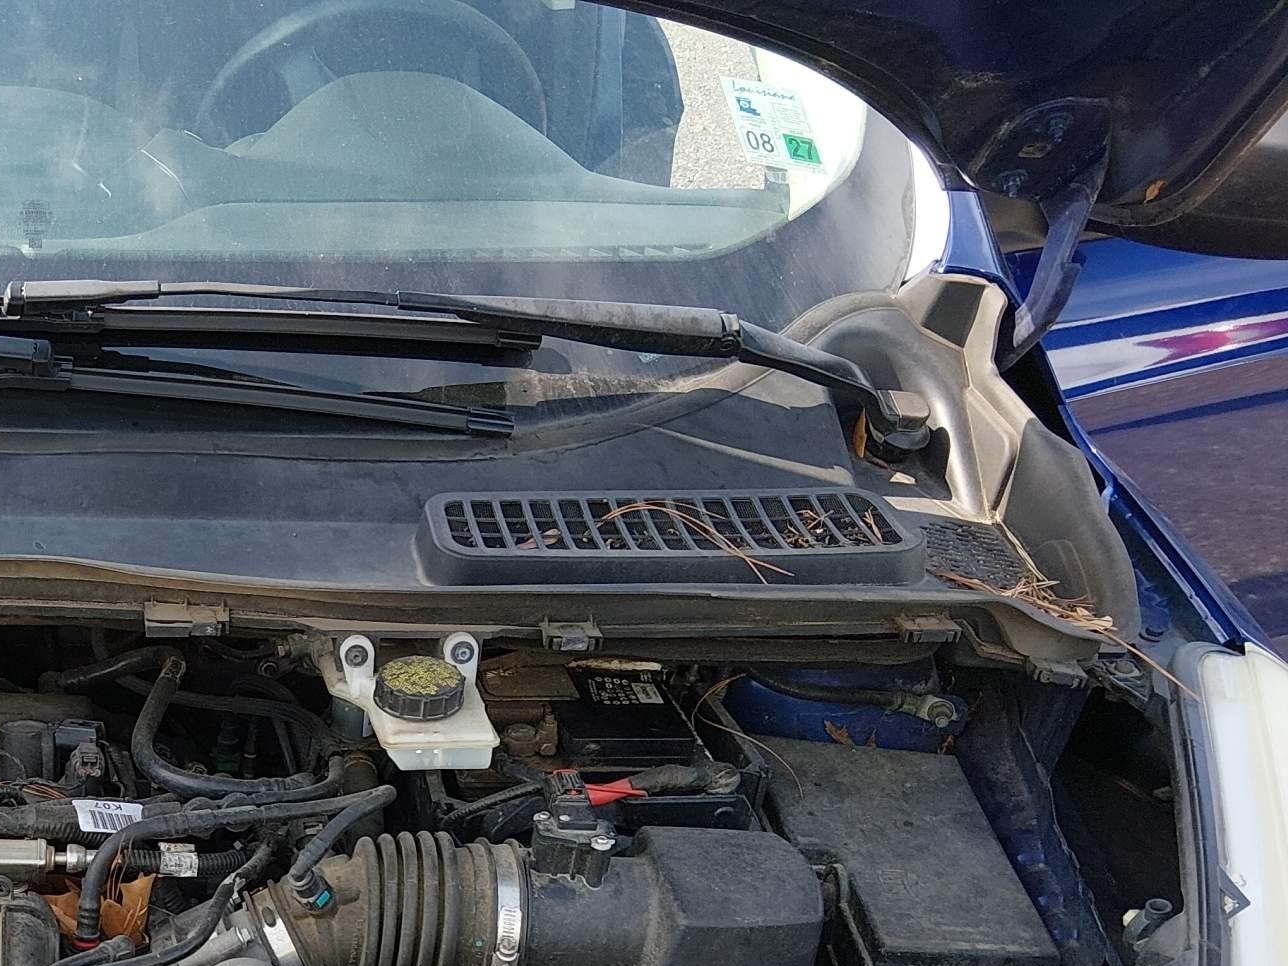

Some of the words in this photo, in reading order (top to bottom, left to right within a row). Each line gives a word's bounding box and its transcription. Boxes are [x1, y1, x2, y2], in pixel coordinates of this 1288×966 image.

[746, 130, 775, 153] 08
[788, 138, 813, 160] 27
[94, 802, 123, 811] K07
